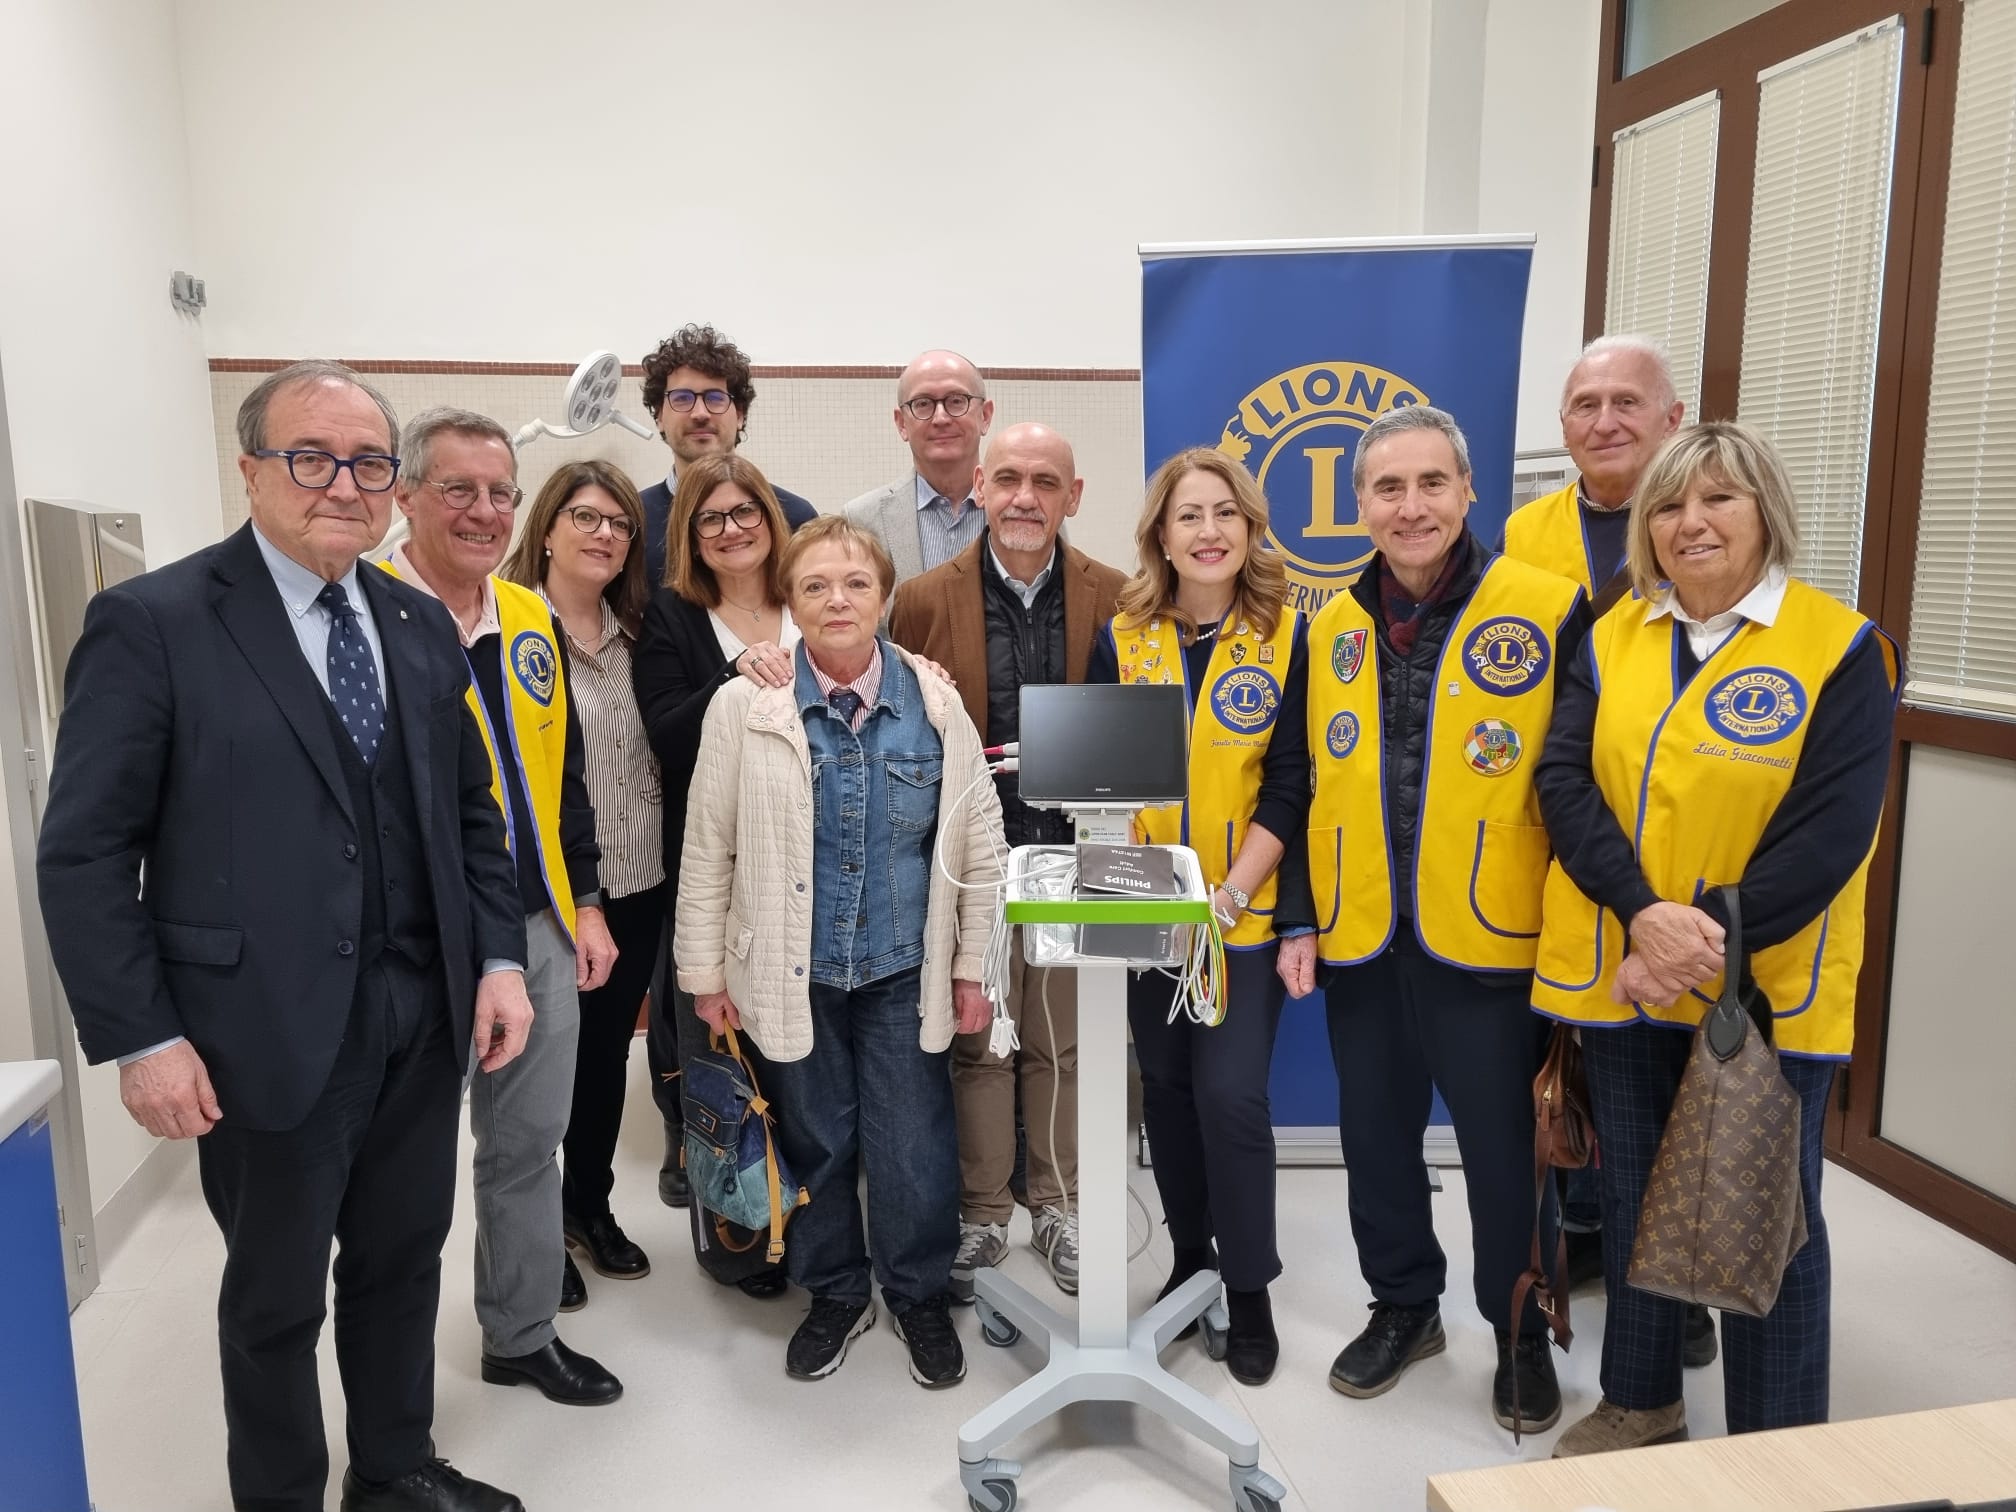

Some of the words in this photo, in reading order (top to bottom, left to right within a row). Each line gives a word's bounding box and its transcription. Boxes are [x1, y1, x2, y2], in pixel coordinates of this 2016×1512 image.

[1302, 447, 1371, 537] L
[1486, 625, 1529, 639] LIONS
[1344, 647, 1352, 660] L
[1497, 641, 1517, 664] L
[531, 654, 547, 677] L
[1231, 673, 1267, 688] LIONS
[1485, 669, 1527, 684] INTERNATIONAL
[1738, 674, 1786, 691] LIONS
[1238, 686, 1256, 707] L
[1741, 689, 1767, 714] L
[1338, 726, 1346, 740] L
[1722, 716, 1778, 733] INTERNATIONAL
[1693, 742, 1727, 757] Lidia
[1729, 748, 1795, 769] Giacometti
[1122, 866, 1145, 875] Comfort
[1104, 875, 1152, 889] PHILIPS
